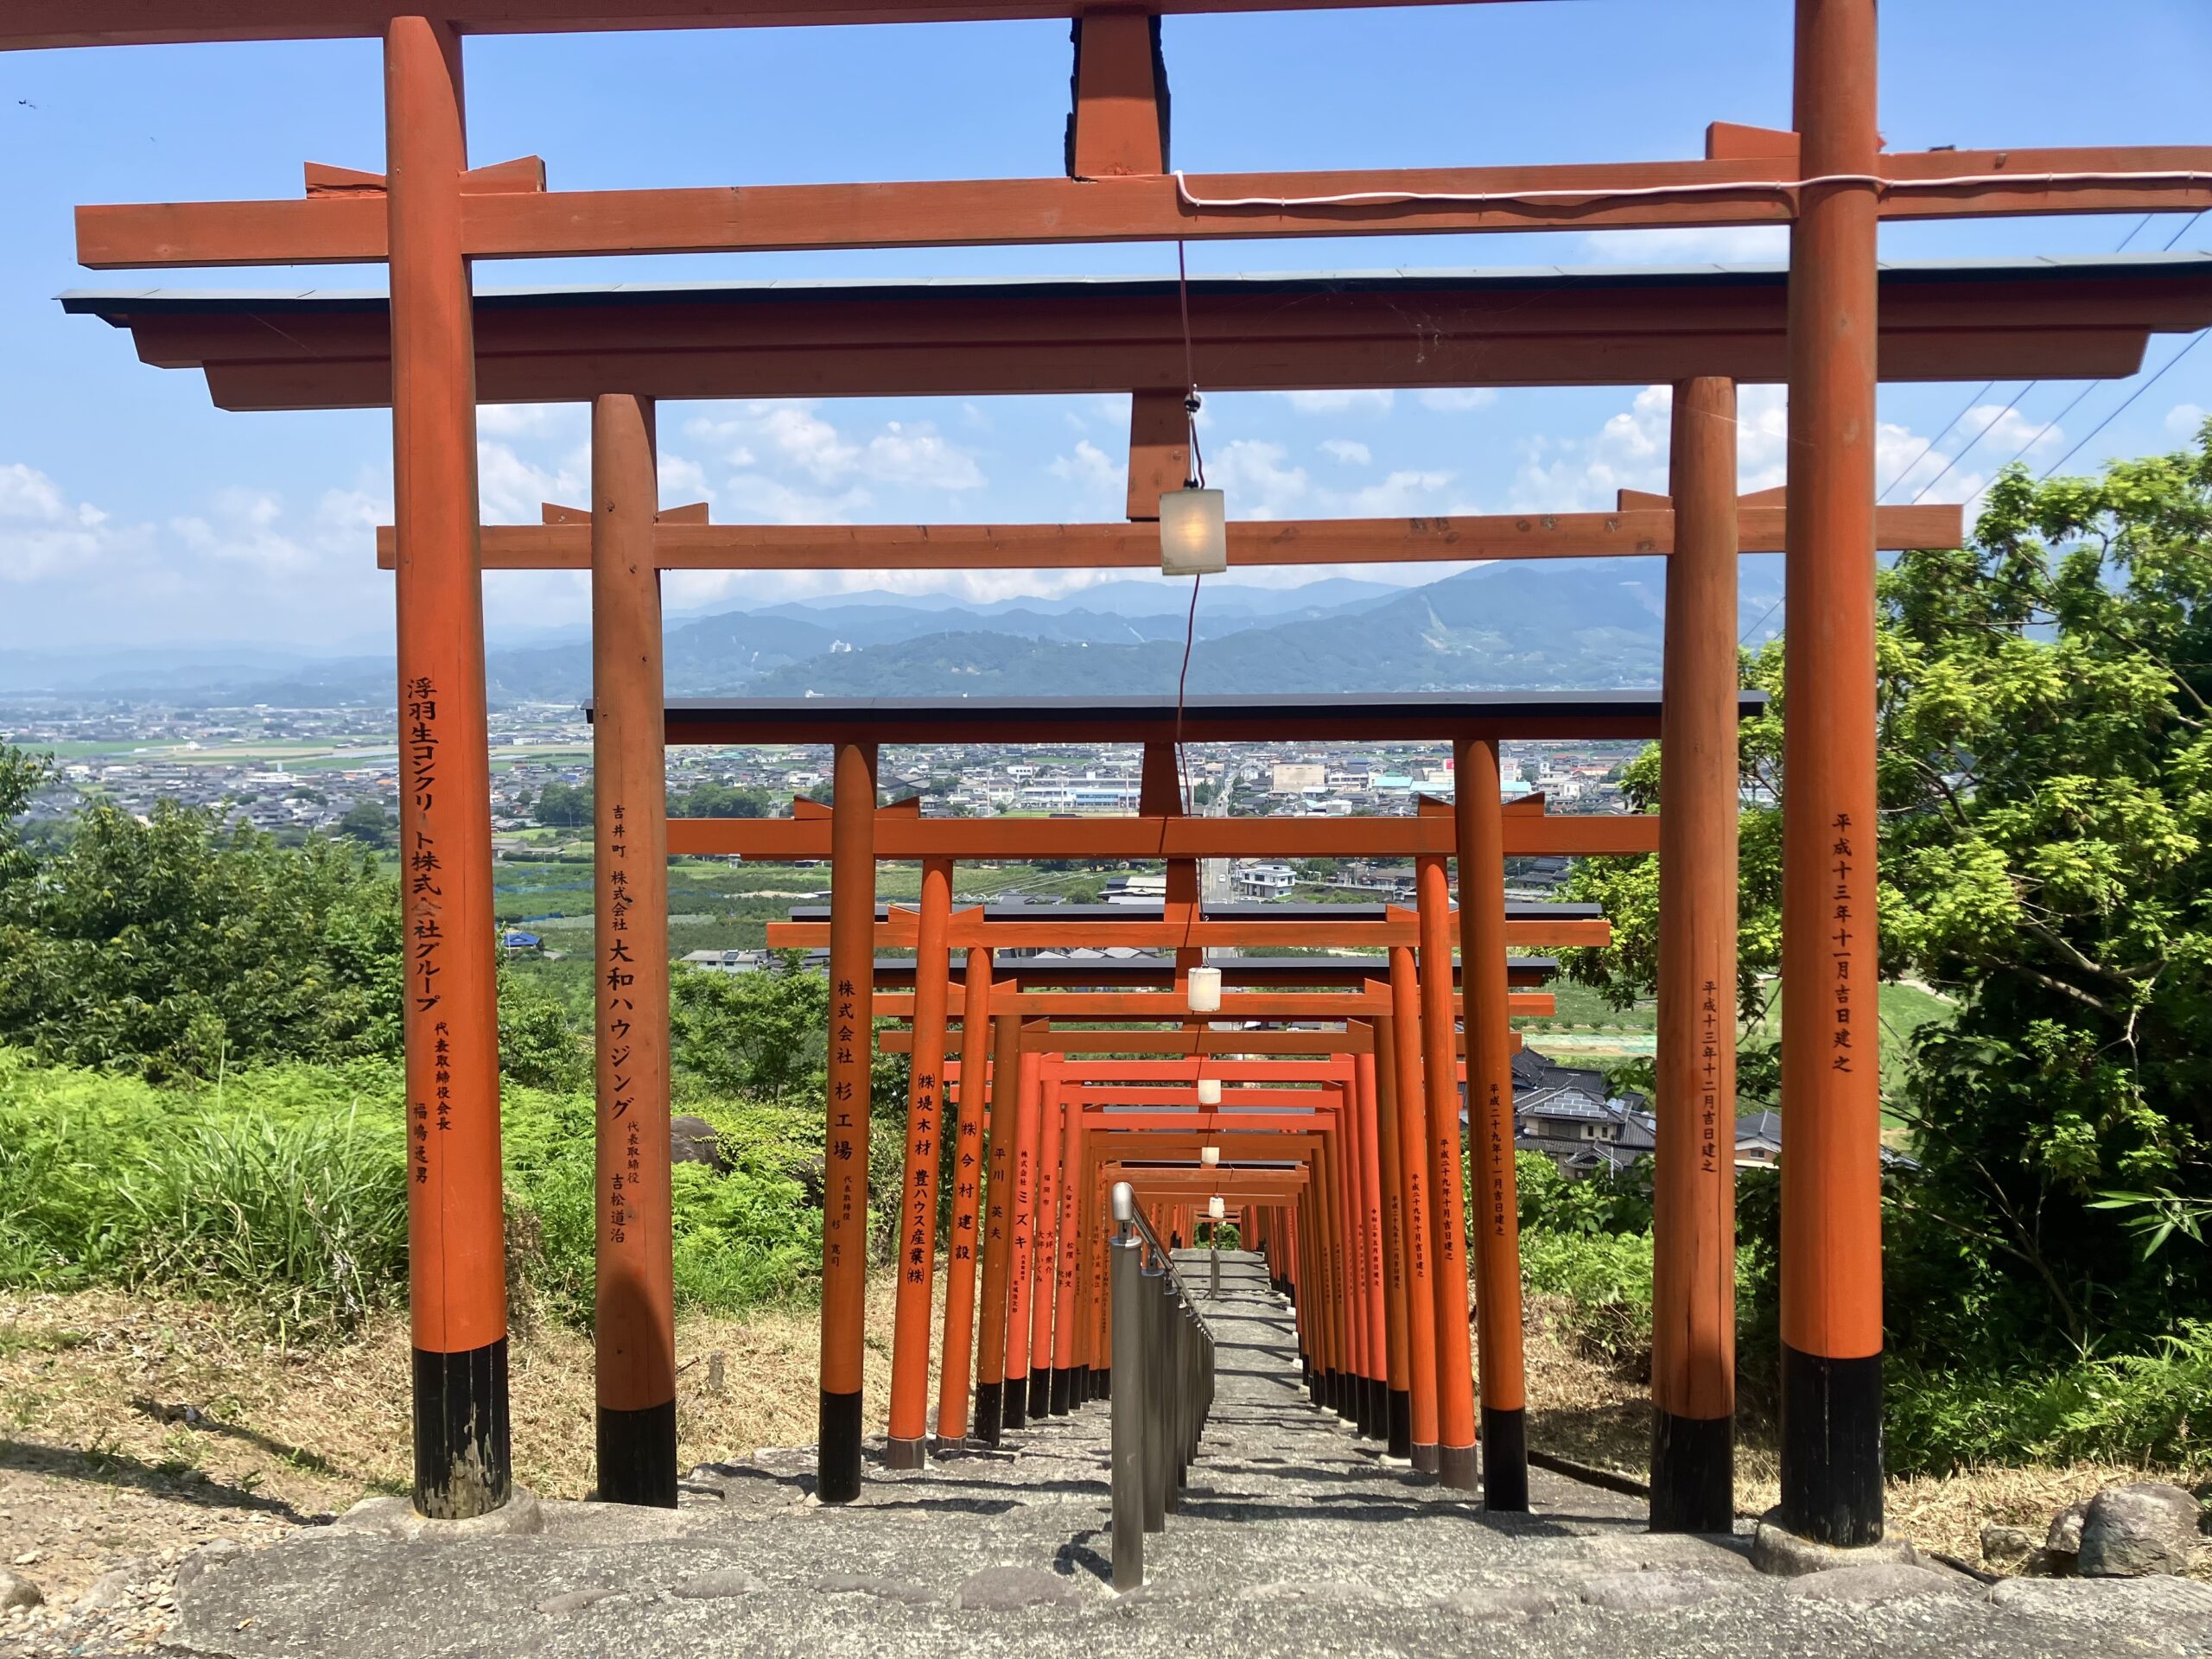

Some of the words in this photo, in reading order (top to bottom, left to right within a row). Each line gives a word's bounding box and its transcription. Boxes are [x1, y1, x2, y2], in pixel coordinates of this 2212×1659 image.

[408, 677, 444, 1012] 浮羽生コンクリト株式会社グループ
[611, 804, 626, 858] 吉井町
[1832, 813, 1853, 1073] 平成十三年十一月吉日建之
[435, 1021, 453, 1131] 代表取締役会長
[1701, 981, 1717, 1173] 平成十三年十二月吉日建之
[627, 1121, 641, 1184] 代表取締役
[993, 1147, 1006, 1183] 平川
[1440, 1139, 1453, 1261] 平成二十九年十月吉日建之
[1490, 1084, 1505, 1236] 平成二十九年十一月吉日建之
[610, 1173, 626, 1243] 吉松道治
[990, 1206, 1002, 1240] 英夫
[1412, 1173, 1425, 1278] 平成二十九年十月吉日建之
